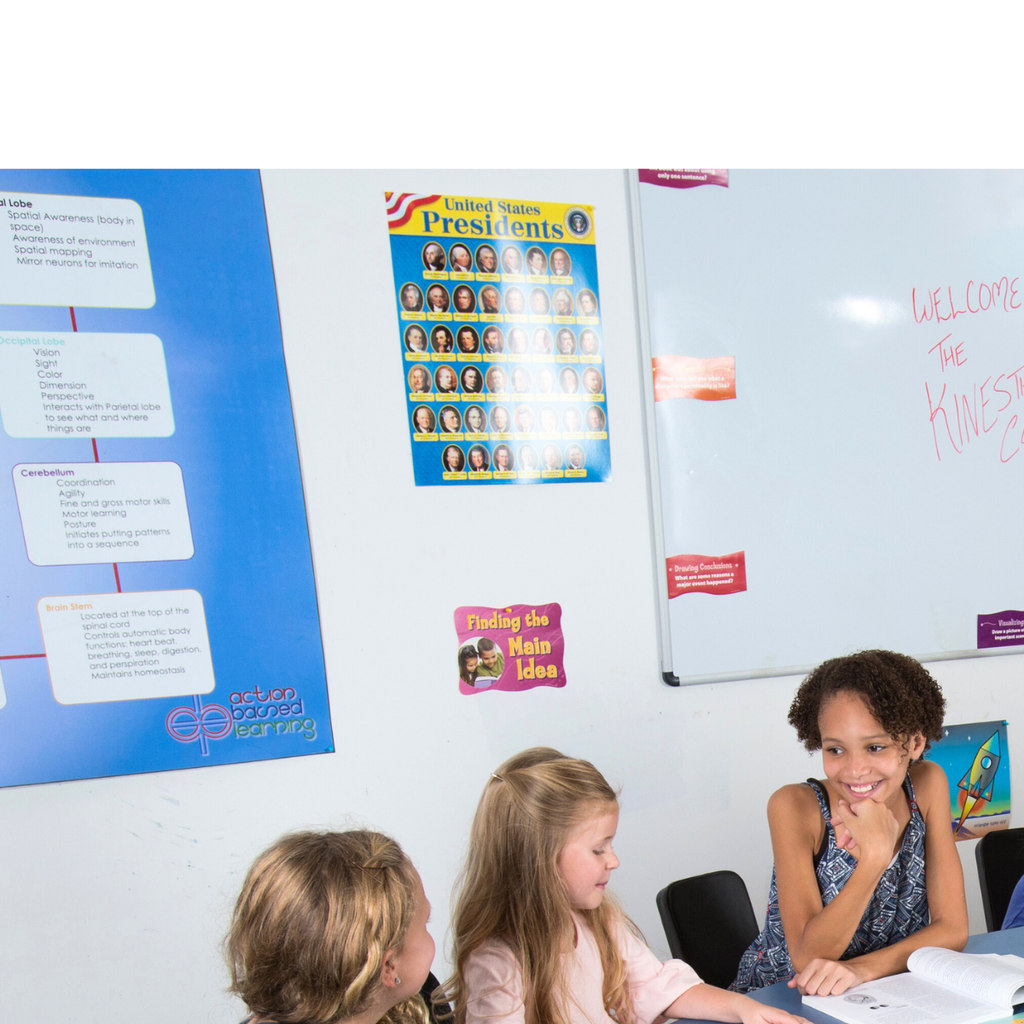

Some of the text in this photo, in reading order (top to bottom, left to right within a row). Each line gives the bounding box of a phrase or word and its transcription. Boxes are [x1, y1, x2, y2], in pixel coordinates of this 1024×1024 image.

[9, 199, 32, 208] Lobe
[444, 198, 540, 215] United States
[8, 210, 135, 226] Spatial Awareness (body in
[10, 223, 44, 233] space)
[420, 210, 564, 240] Presidents
[13, 234, 136, 247] Awareness of environment
[14, 245, 92, 258] Spatial mapping
[17, 257, 139, 270] Mirror neurons for imitation
[912, 276, 1022, 324] WELCOME
[42, 337, 65, 346] Lobe
[33, 348, 60, 356] Vision
[928, 333, 968, 372] THE
[35, 359, 58, 368] Sight
[38, 370, 63, 378] Color
[39, 382, 87, 390] Dimension
[41, 392, 94, 401] Perspective
[43, 403, 161, 411] Interacts with Parietal lobe
[47, 424, 73, 434] things
[21, 469, 74, 477] Cerebellum
[56, 478, 115, 487] Coordination
[59, 488, 86, 499] Agility
[101, 500, 123, 508] gross
[125, 498, 151, 506] motor
[153, 497, 170, 505] skills
[90, 509, 127, 519] learning
[64, 520, 96, 528] Posture
[65, 528, 170, 539] Initiates putting patterns
[95, 540, 139, 549] sequence
[674, 562, 732, 573] Drawing Conclusions
[46, 602, 92, 611] Brain Stem
[80, 607, 189, 620] Located at the top of the
[82, 620, 130, 631] spinal cord
[467, 609, 550, 633] Finding the
[998, 618, 1024, 627] Visualizing
[84, 626, 191, 640] Controls automatic body
[86, 637, 178, 650] functions: heart beat,
[508, 636, 552, 657] Main
[88, 646, 202, 660] breathing, sleep, digestion,
[89, 658, 159, 670] and perspiration
[516, 658, 558, 681] Idea
[91, 666, 185, 680] Maintains homeostasis
[228, 685, 296, 706] action
[232, 716, 316, 740] learning
